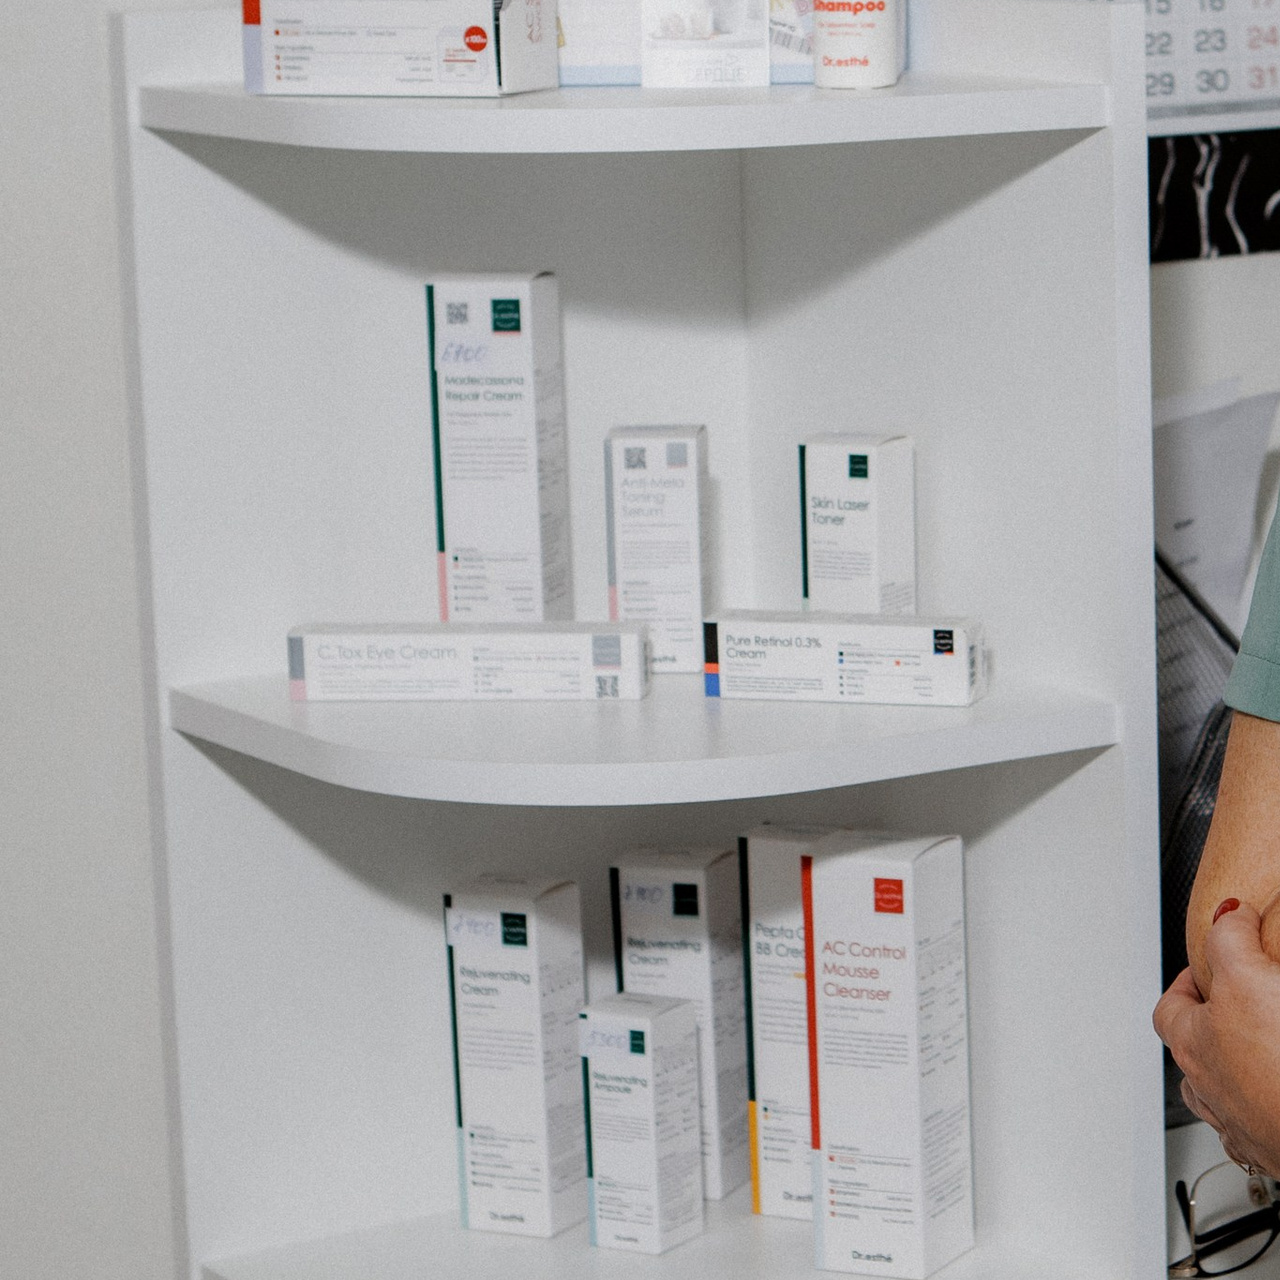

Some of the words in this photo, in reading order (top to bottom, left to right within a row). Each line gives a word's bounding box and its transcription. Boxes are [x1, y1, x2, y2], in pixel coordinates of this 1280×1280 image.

[1144, 31, 1174, 57] 22
[1194, 28, 1229, 53] 23
[1247, 26, 1280, 50] 24
[1144, 72, 1177, 98] 29
[1196, 68, 1231, 93] 30
[1249, 65, 1278, 89] 31
[482, 389, 523, 401] Cream
[811, 496, 835, 509] Skin
[837, 498, 870, 511] Laser
[811, 512, 846, 526] Toner
[725, 635, 751, 647] Pure
[754, 636, 792, 648] Retinol
[794, 637, 822, 648] 0.3%
[337, 645, 362, 660] Tox
[366, 645, 396, 663] Eye
[399, 645, 458, 660] Cream
[725, 647, 767, 660] Cream
[823, 941, 846, 956] AC
[849, 941, 908, 961] Control
[629, 954, 668, 965] Cream
[823, 962, 881, 980] Mousse
[461, 982, 499, 996] Cream
[823, 982, 893, 1002] Cleanser
